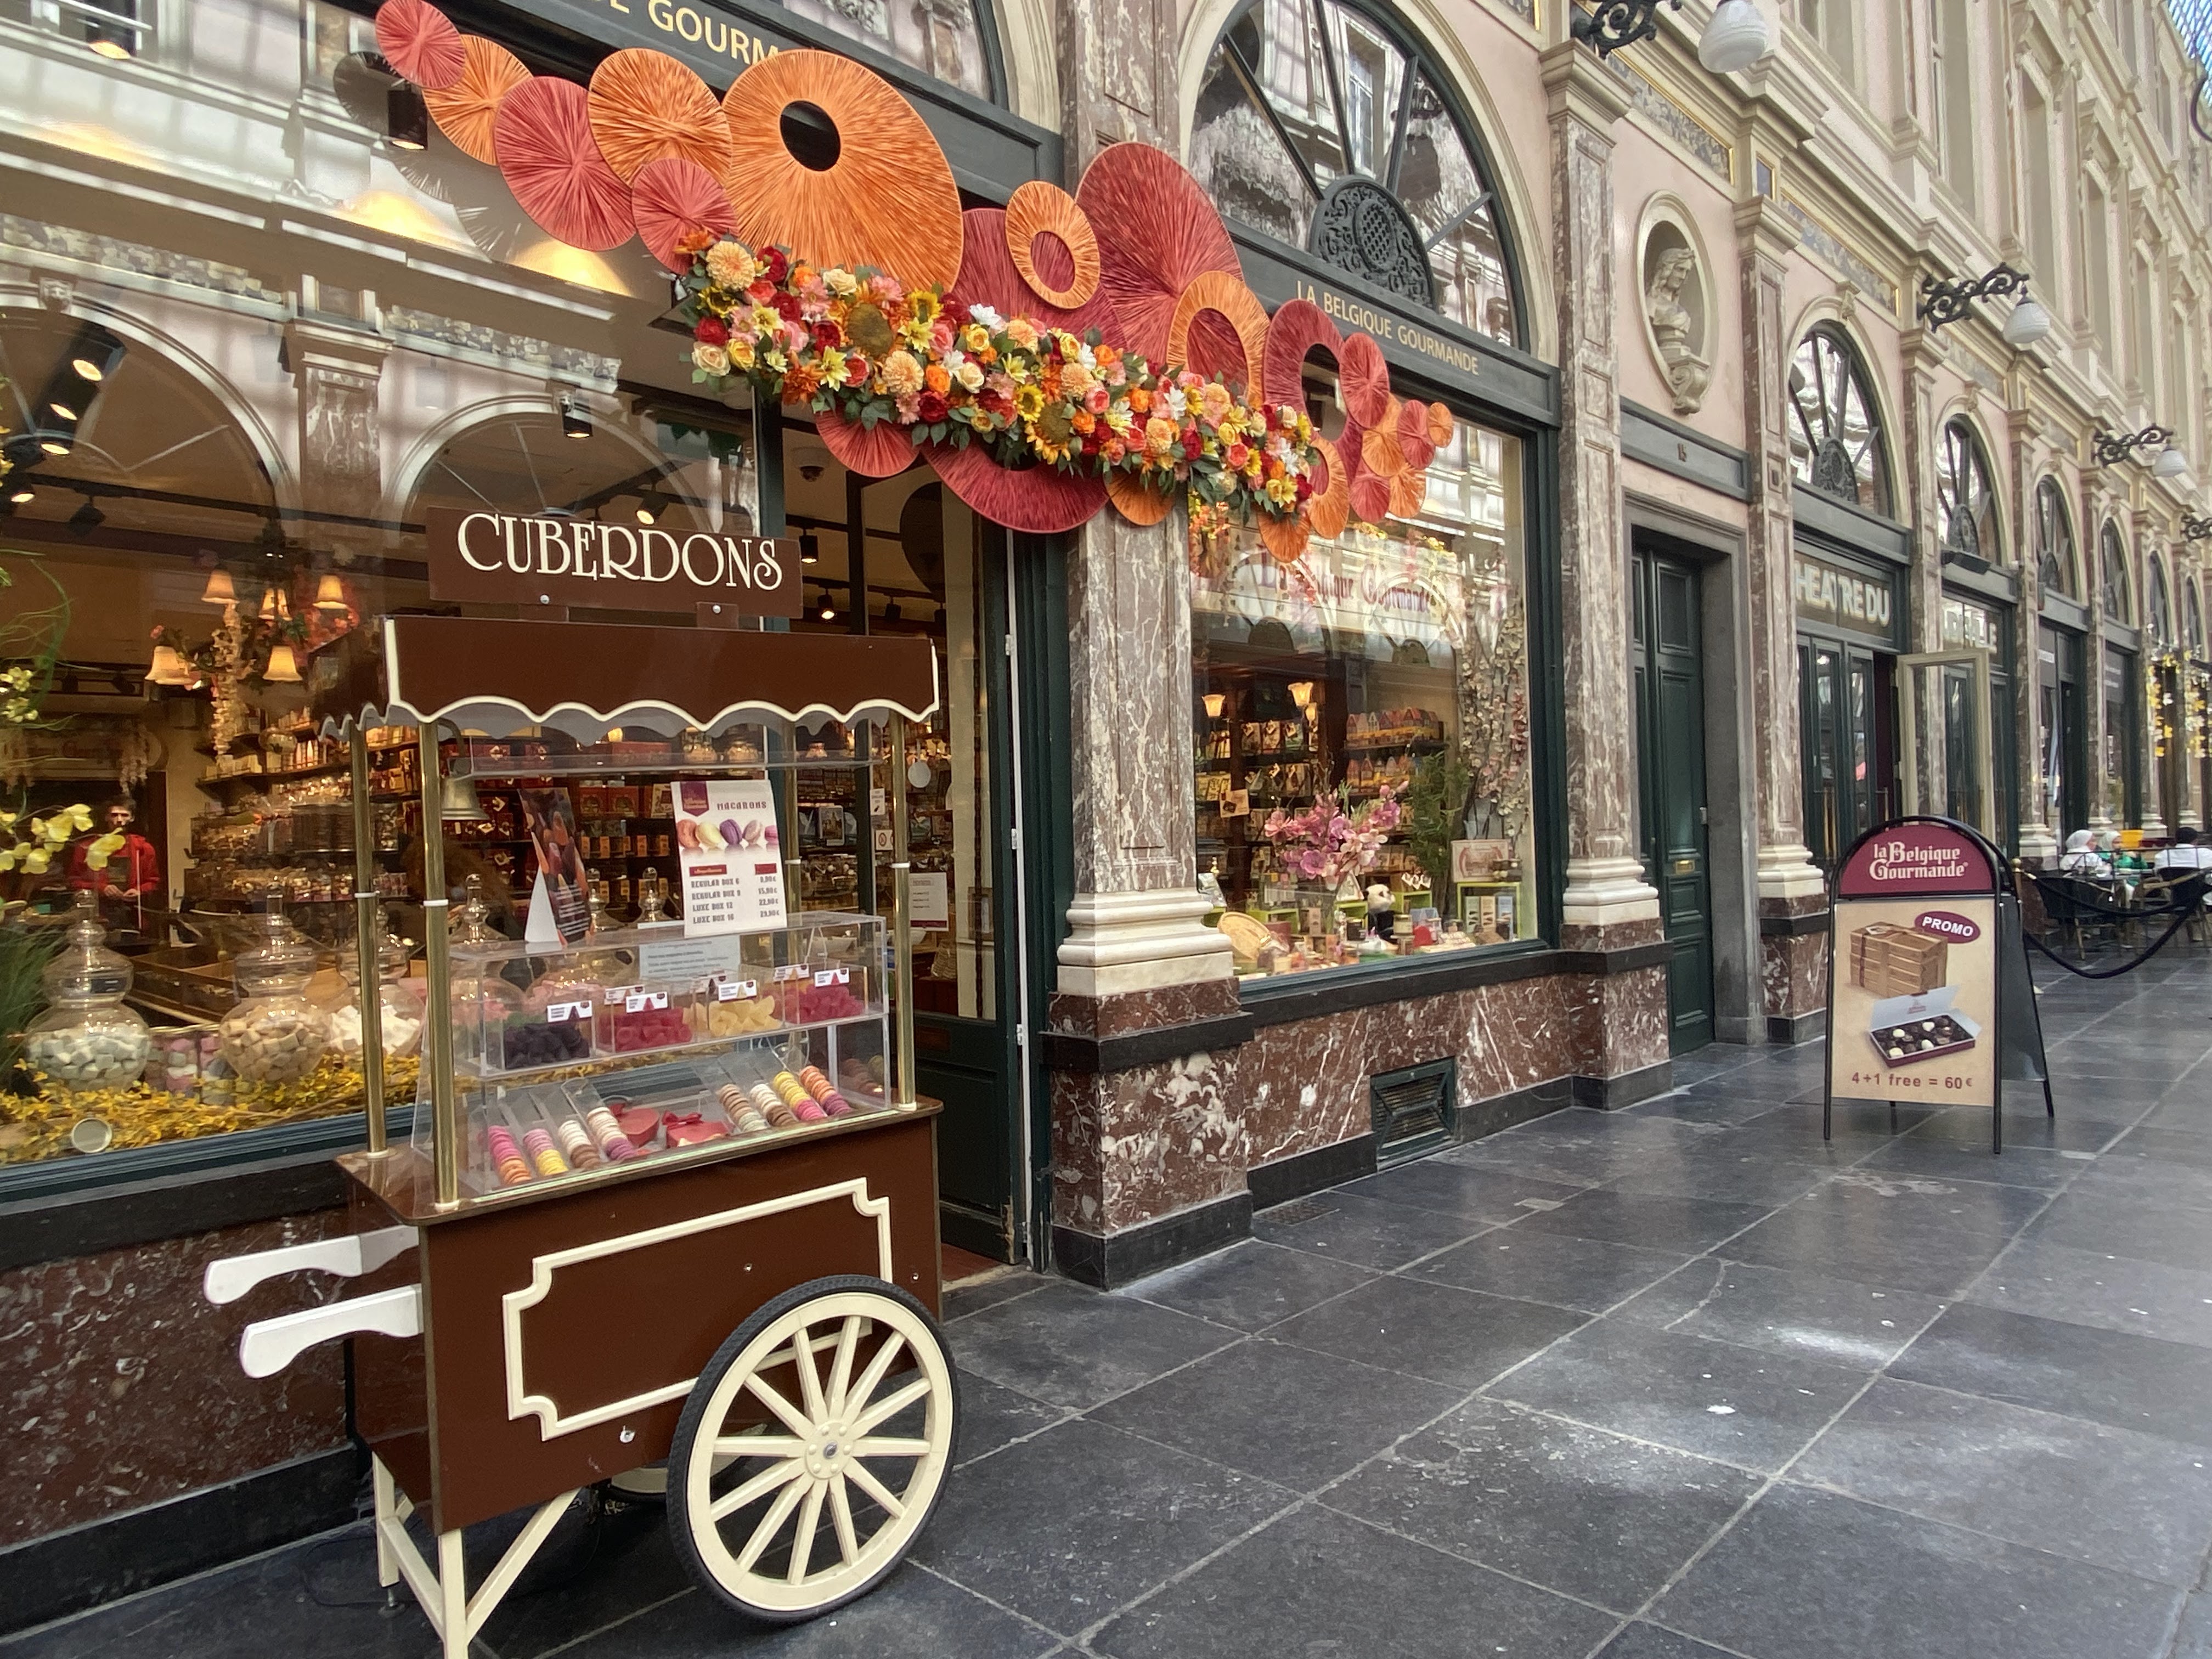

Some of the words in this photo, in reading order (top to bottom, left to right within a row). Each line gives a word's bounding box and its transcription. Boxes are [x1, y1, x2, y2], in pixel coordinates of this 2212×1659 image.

[1297, 280, 1316, 305] LA
[1323, 292, 1392, 340] BELGIQUE
[1397, 325, 1479, 376] GOURMANDE
[457, 512, 783, 591] CUBERDONS
[1865, 583, 1890, 628] DU
[716, 801, 767, 811] MACARONS
[1874, 843, 1887, 859] la
[1886, 841, 1961, 867] Belgique
[1869, 859, 1965, 880] Gourmande
[691, 879, 720, 888] REGULAR
[721, 878, 734, 886] BOX
[691, 890, 721, 900] REGULAR
[723, 889, 735, 898] BOX
[692, 903, 710, 912] LUXE
[712, 902, 725, 910] BOX
[693, 915, 711, 924] LUXE
[713, 914, 725, 922] BOX
[1922, 916, 1974, 937] PROMO
[1889, 1074, 1921, 1087] free
